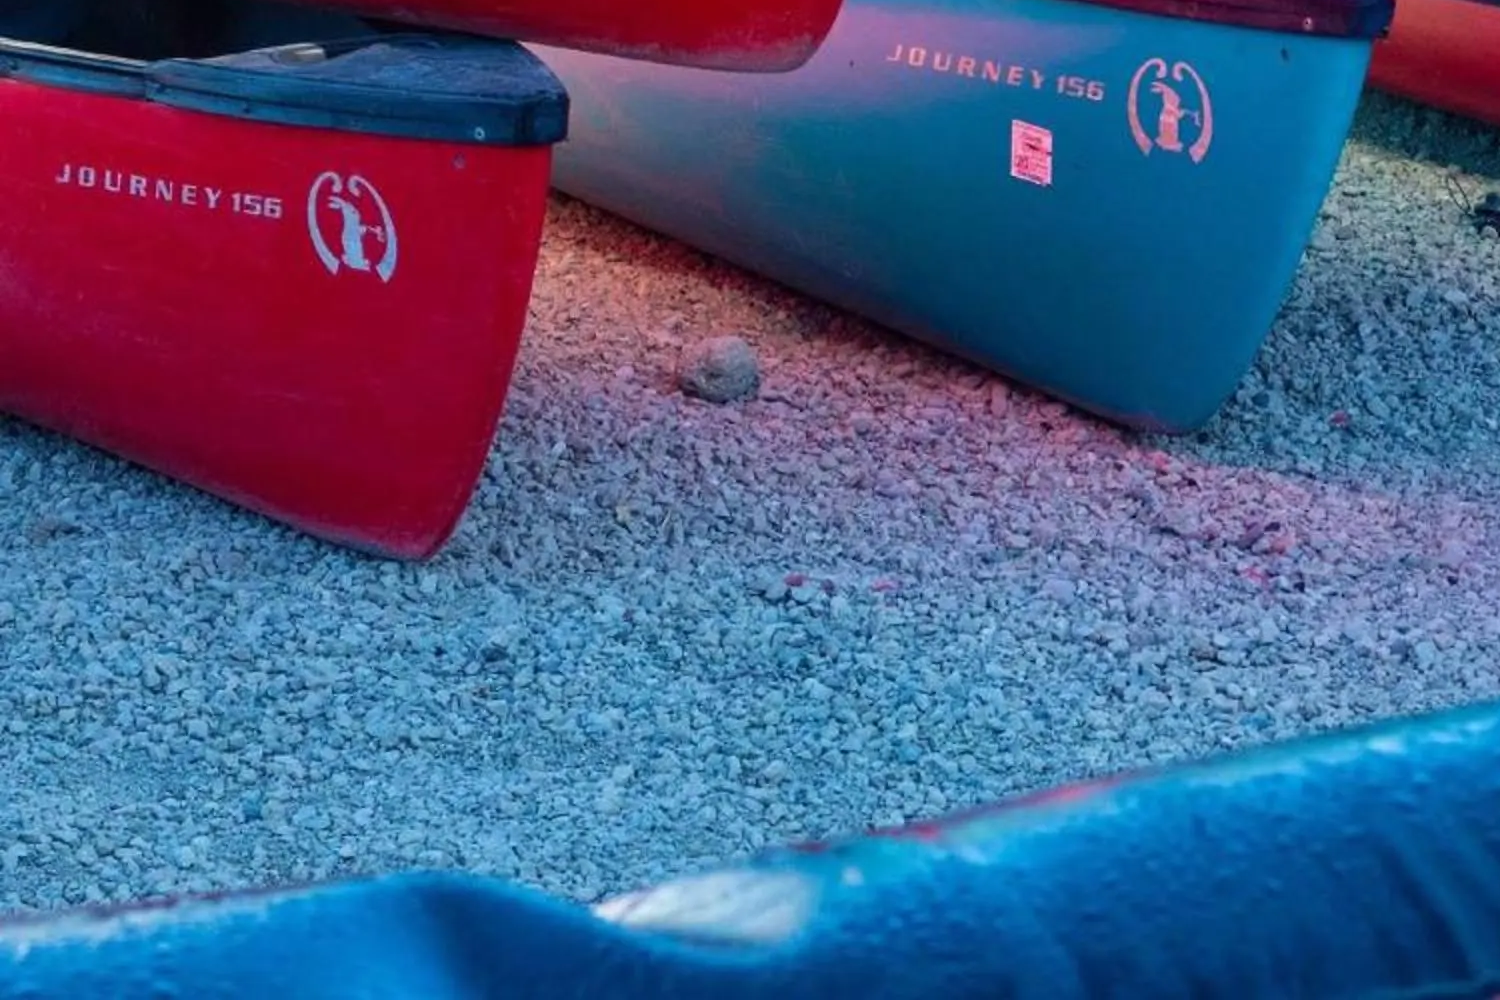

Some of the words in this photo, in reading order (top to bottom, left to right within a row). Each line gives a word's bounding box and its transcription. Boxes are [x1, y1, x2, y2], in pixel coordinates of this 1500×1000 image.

[886, 44, 1046, 90] JOURNEY
[1056, 73, 1106, 101] 156
[55, 163, 222, 209] JOURNEY
[231, 192, 284, 219] 156
